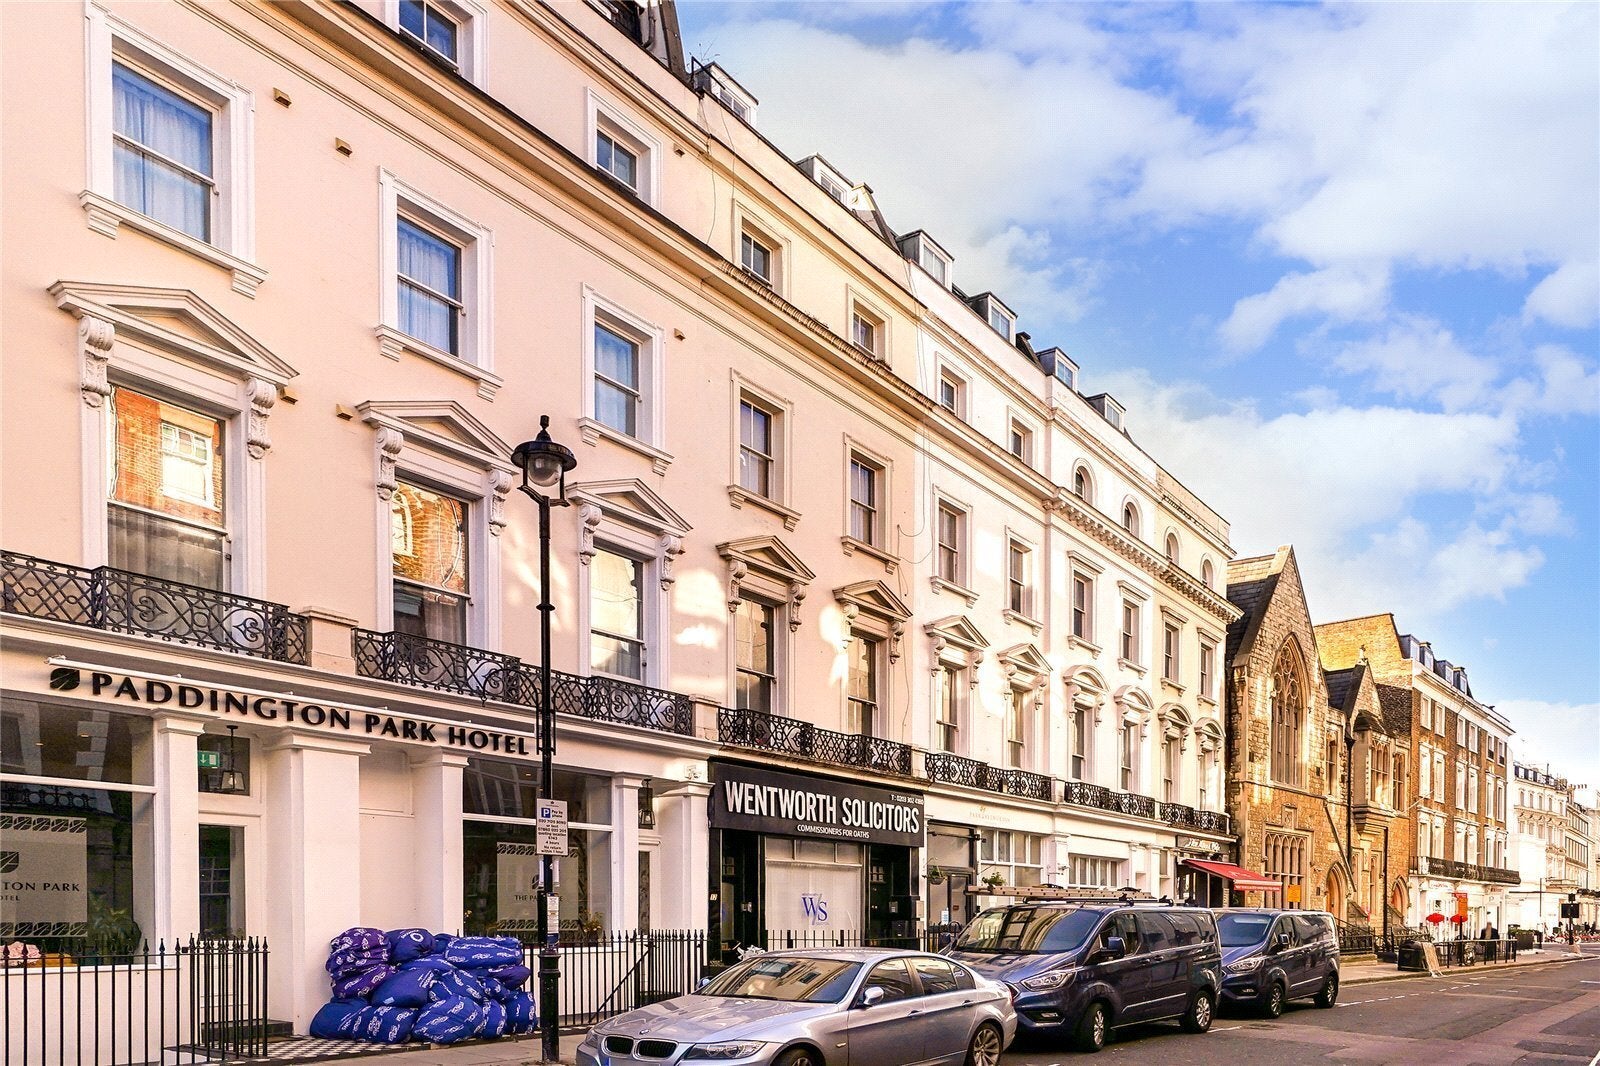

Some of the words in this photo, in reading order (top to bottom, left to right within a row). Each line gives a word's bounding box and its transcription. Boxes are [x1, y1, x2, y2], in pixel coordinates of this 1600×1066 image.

[92, 672, 350, 730] PADDINGTON
[365, 713, 437, 742] PARK
[448, 726, 530, 755] HOTEL
[725, 780, 836, 824] WENTWORTH
[842, 797, 920, 833] SOLICITORS
[797, 824, 842, 835] COMMISSIONERS
[842, 829, 853, 837] FOR
[853, 830, 870, 839] OATHS
[43, 882, 80, 892] PARK
